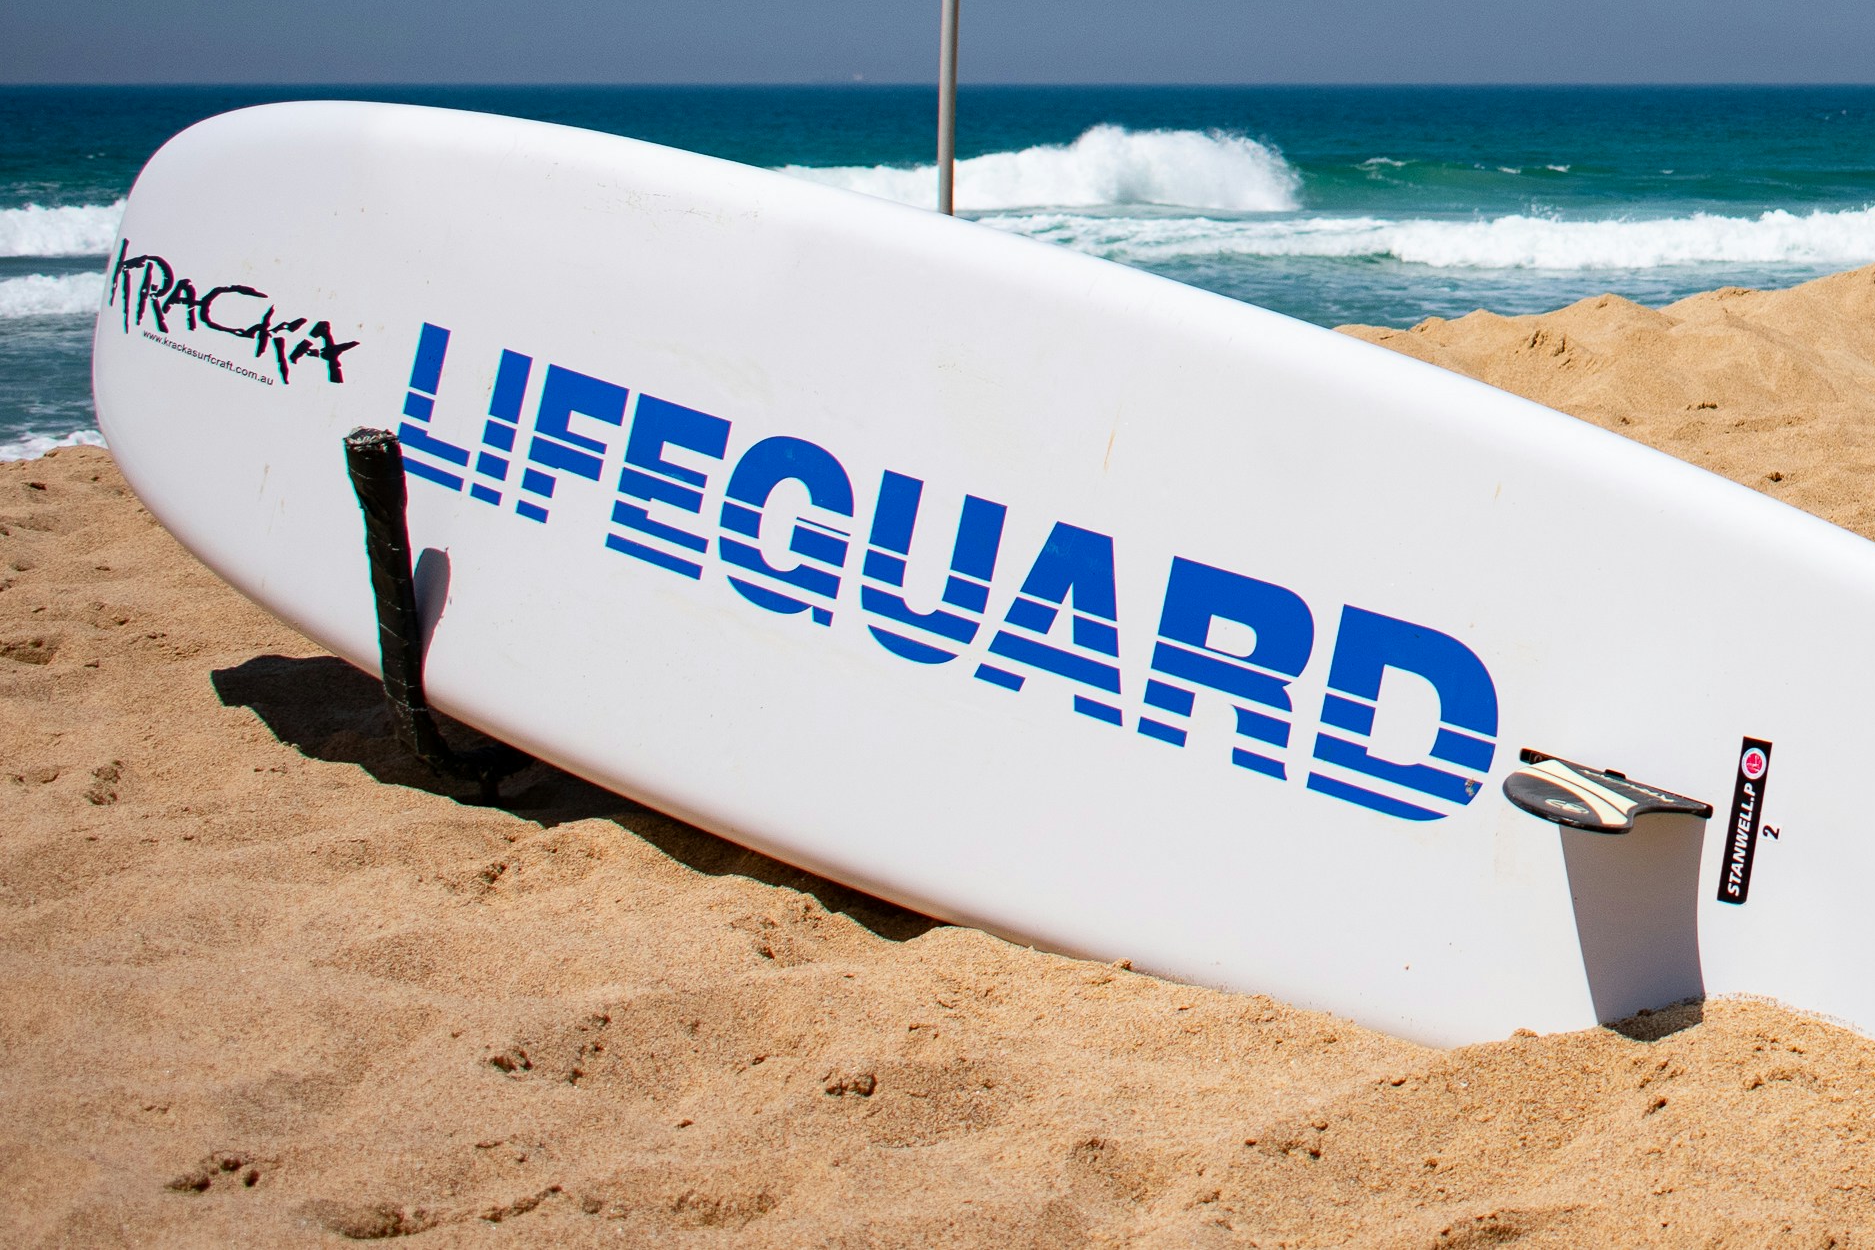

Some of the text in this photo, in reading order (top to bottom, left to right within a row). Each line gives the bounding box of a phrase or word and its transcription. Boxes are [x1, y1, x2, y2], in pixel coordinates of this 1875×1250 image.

[109, 237, 361, 385] KRACKA
[143, 329, 275, 386] www.krackasurfcraft.com.au
[400, 322, 1499, 821] LIFEGUARD
[1762, 824, 1781, 840] 2
